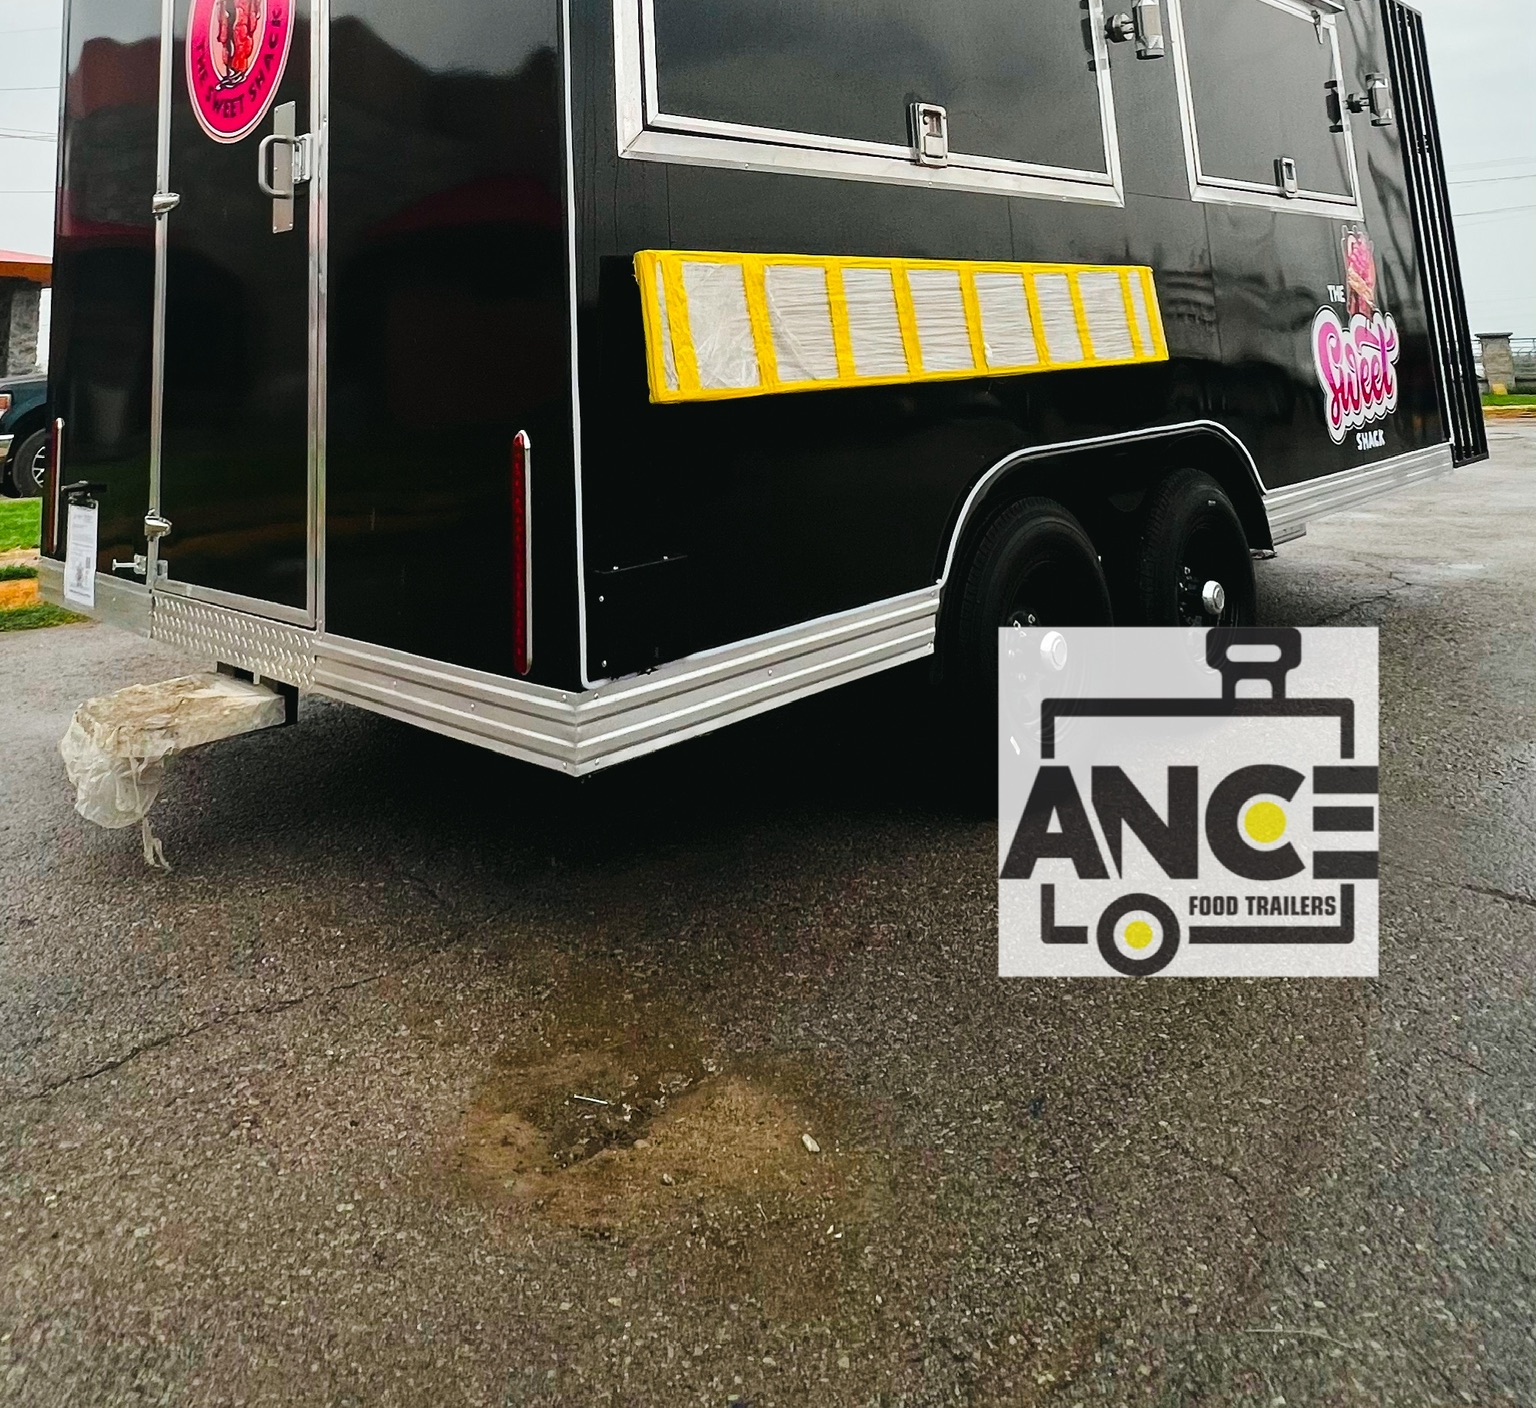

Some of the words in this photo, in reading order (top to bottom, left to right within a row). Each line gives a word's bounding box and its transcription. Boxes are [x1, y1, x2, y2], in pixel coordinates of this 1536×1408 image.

[206, 85, 245, 119] SWEET
[248, 7, 282, 103] SHACK
[1327, 284, 1346, 303] THE
[1317, 320, 1396, 427] Sweet
[1356, 429, 1386, 451] SHACK
